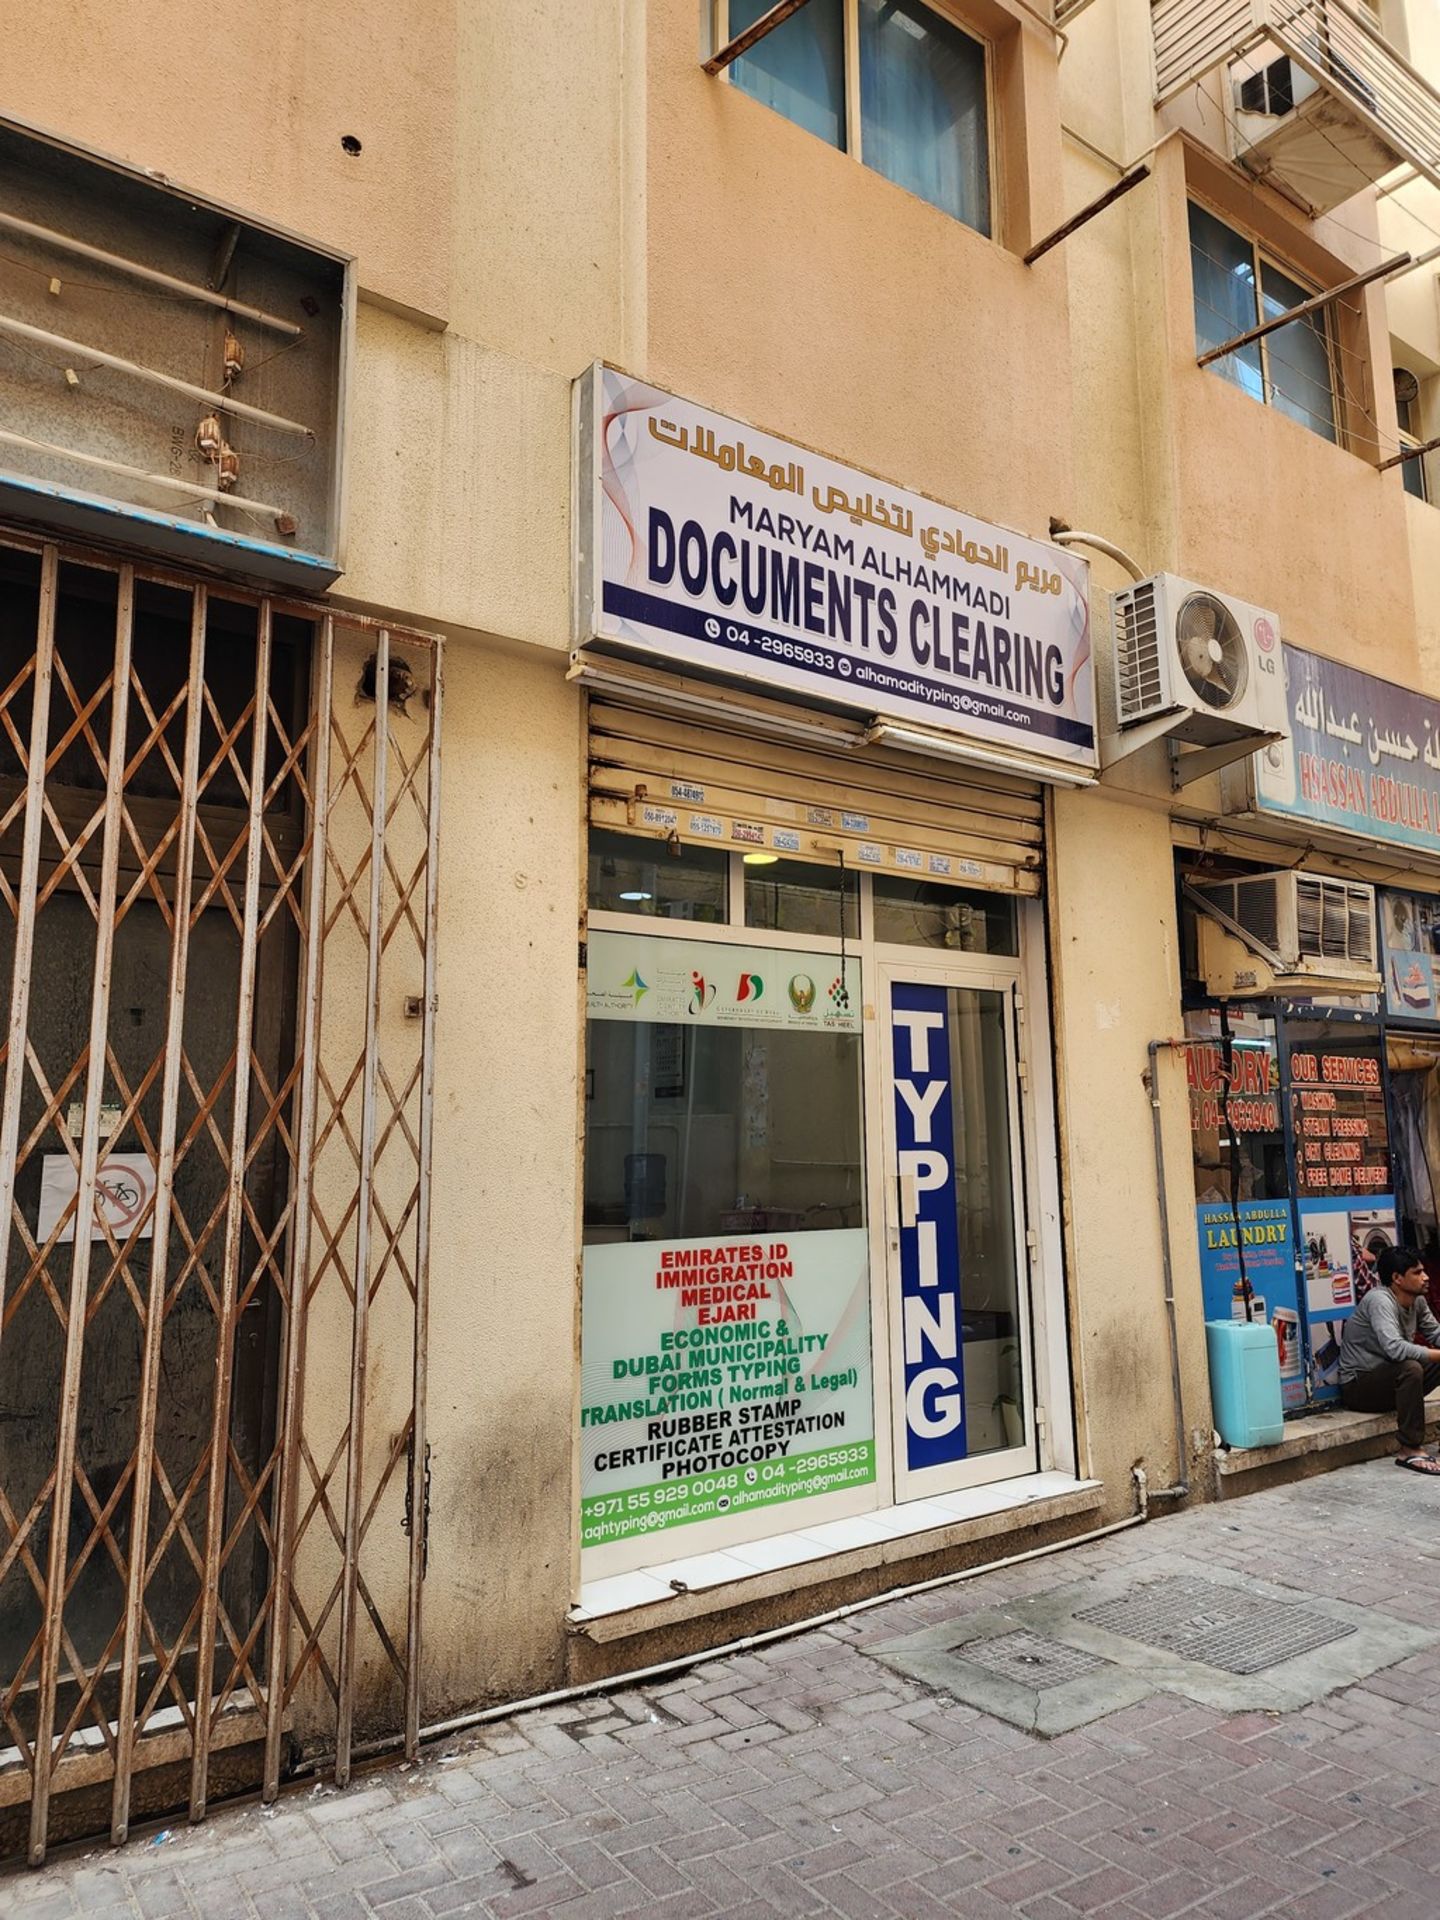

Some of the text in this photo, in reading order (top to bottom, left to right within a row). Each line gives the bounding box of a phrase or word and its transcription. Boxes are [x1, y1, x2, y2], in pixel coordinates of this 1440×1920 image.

[648, 415, 1062, 596] مريم الحمادي لتخليص المعاملات
[730, 495, 1011, 620] MARYAM ALHAMMADI
[648, 505, 1065, 705] DOCUMENTS CLEARING
[726, 626, 1031, 726] 04 -2965933 alhamadityping@gmail.com
[1258, 655, 1276, 676] LG
[1367, 716, 1418, 765] حسن
[1370, 773, 1432, 834] ABDULLA
[1291, 1053, 1380, 1085] OUR SERVICES
[1301, 1091, 1337, 1111] WASHING
[1303, 1117, 1369, 1137] STEAM PRESSING
[1304, 1142, 1361, 1162] DRY CLEANING
[1306, 1167, 1388, 1187] FREE HOME DELIVERY
[892, 1010, 962, 1440] TYPING
[1245, 1208, 1288, 1221] ABDULLA
[655, 1261, 794, 1289] IMMIGRATION
[661, 1243, 789, 1269] EMIRATES ID
[681, 1282, 772, 1307] MEDICAL
[698, 1303, 757, 1326] EJARI
[660, 1318, 790, 1351] ECONOMIC &
[612, 1333, 830, 1379] DUBAI MUNICIPALITY
[648, 1356, 802, 1395] FORMS TYPING
[580, 1389, 713, 1428] TRANSLATION
[729, 1377, 789, 1404] Normal
[794, 1375, 807, 1394] &
[811, 1367, 858, 1392] Legal)
[647, 1398, 803, 1441] RUBBER STAMP
[594, 1411, 846, 1473] CERTIFICATE ATTESTATION
[662, 1440, 791, 1480] PHOTOCOPY
[584, 1446, 869, 1518] +971 55 929 0048 04 -2965933
[732, 1465, 869, 1507] alhamadityping@gmail.com
